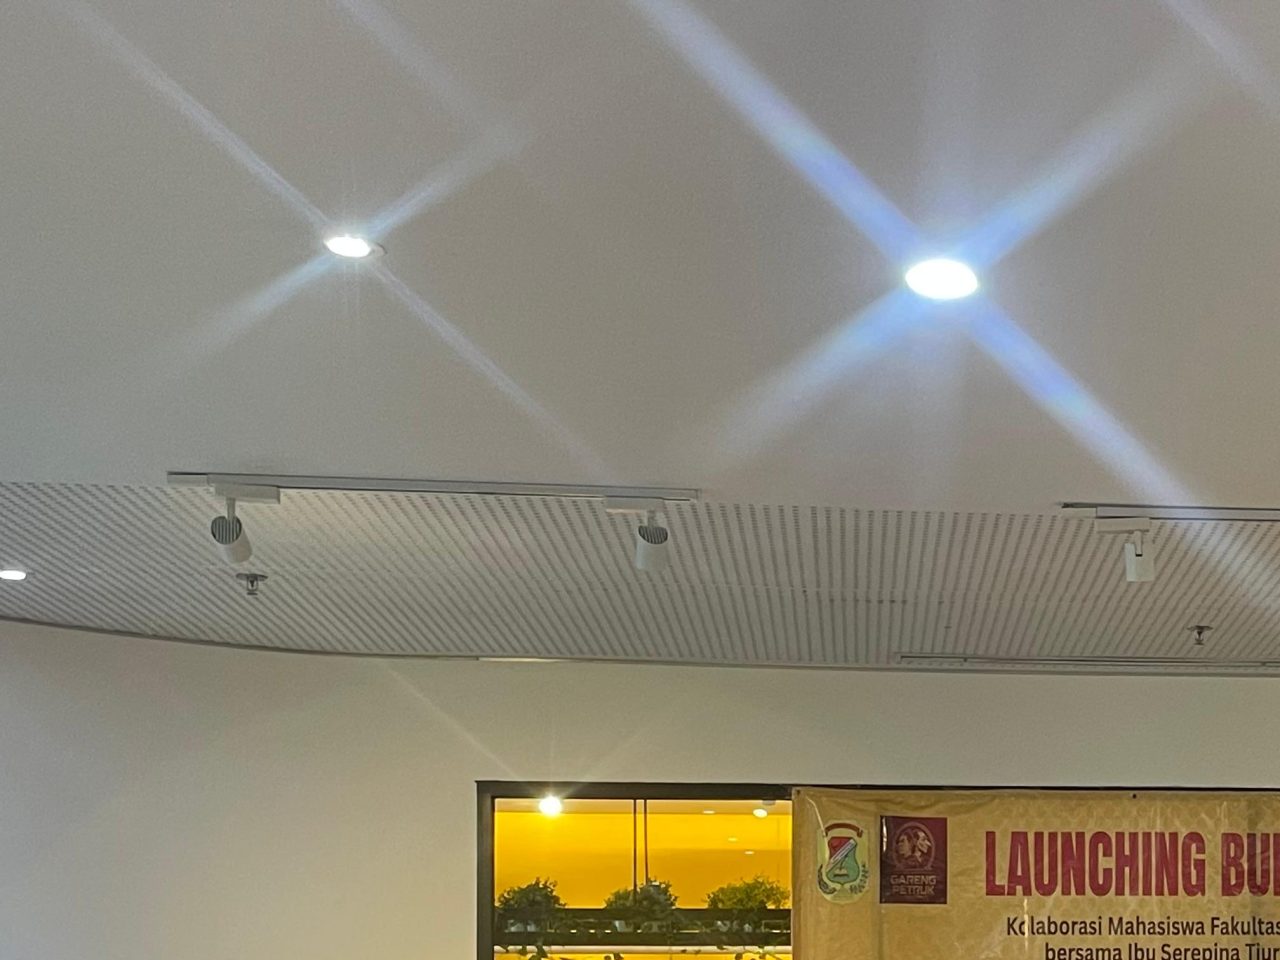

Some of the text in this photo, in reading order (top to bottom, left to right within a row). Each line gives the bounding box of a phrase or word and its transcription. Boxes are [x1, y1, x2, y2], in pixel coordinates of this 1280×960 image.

[985, 831, 1206, 897] LAUNCHING
[890, 874, 937, 885] GARENG
[892, 885, 935, 895] PETRUK
[1006, 916, 1103, 936] Kolaborasi
[1108, 916, 1205, 936] Mahasiswa
